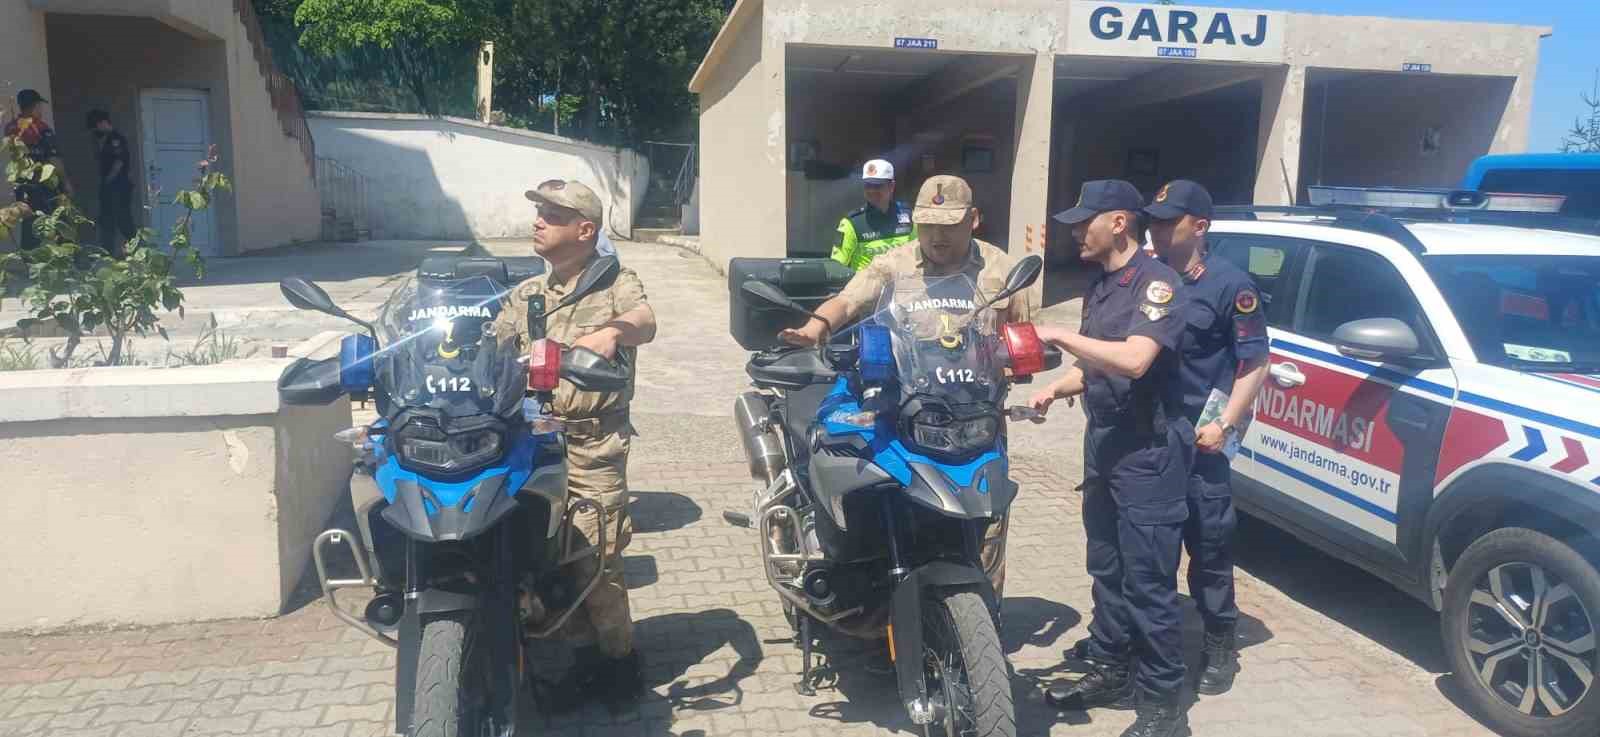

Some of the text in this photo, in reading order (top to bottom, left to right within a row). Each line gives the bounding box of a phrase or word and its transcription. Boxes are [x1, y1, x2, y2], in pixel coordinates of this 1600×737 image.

[1089, 6, 1267, 47] GARAJ
[408, 305, 492, 321] JANDARMA
[907, 298, 976, 313] JANDARMA
[946, 368, 974, 383] 112
[437, 377, 471, 392] 112
[1260, 432, 1391, 495] www.jandarma.gov.tr
